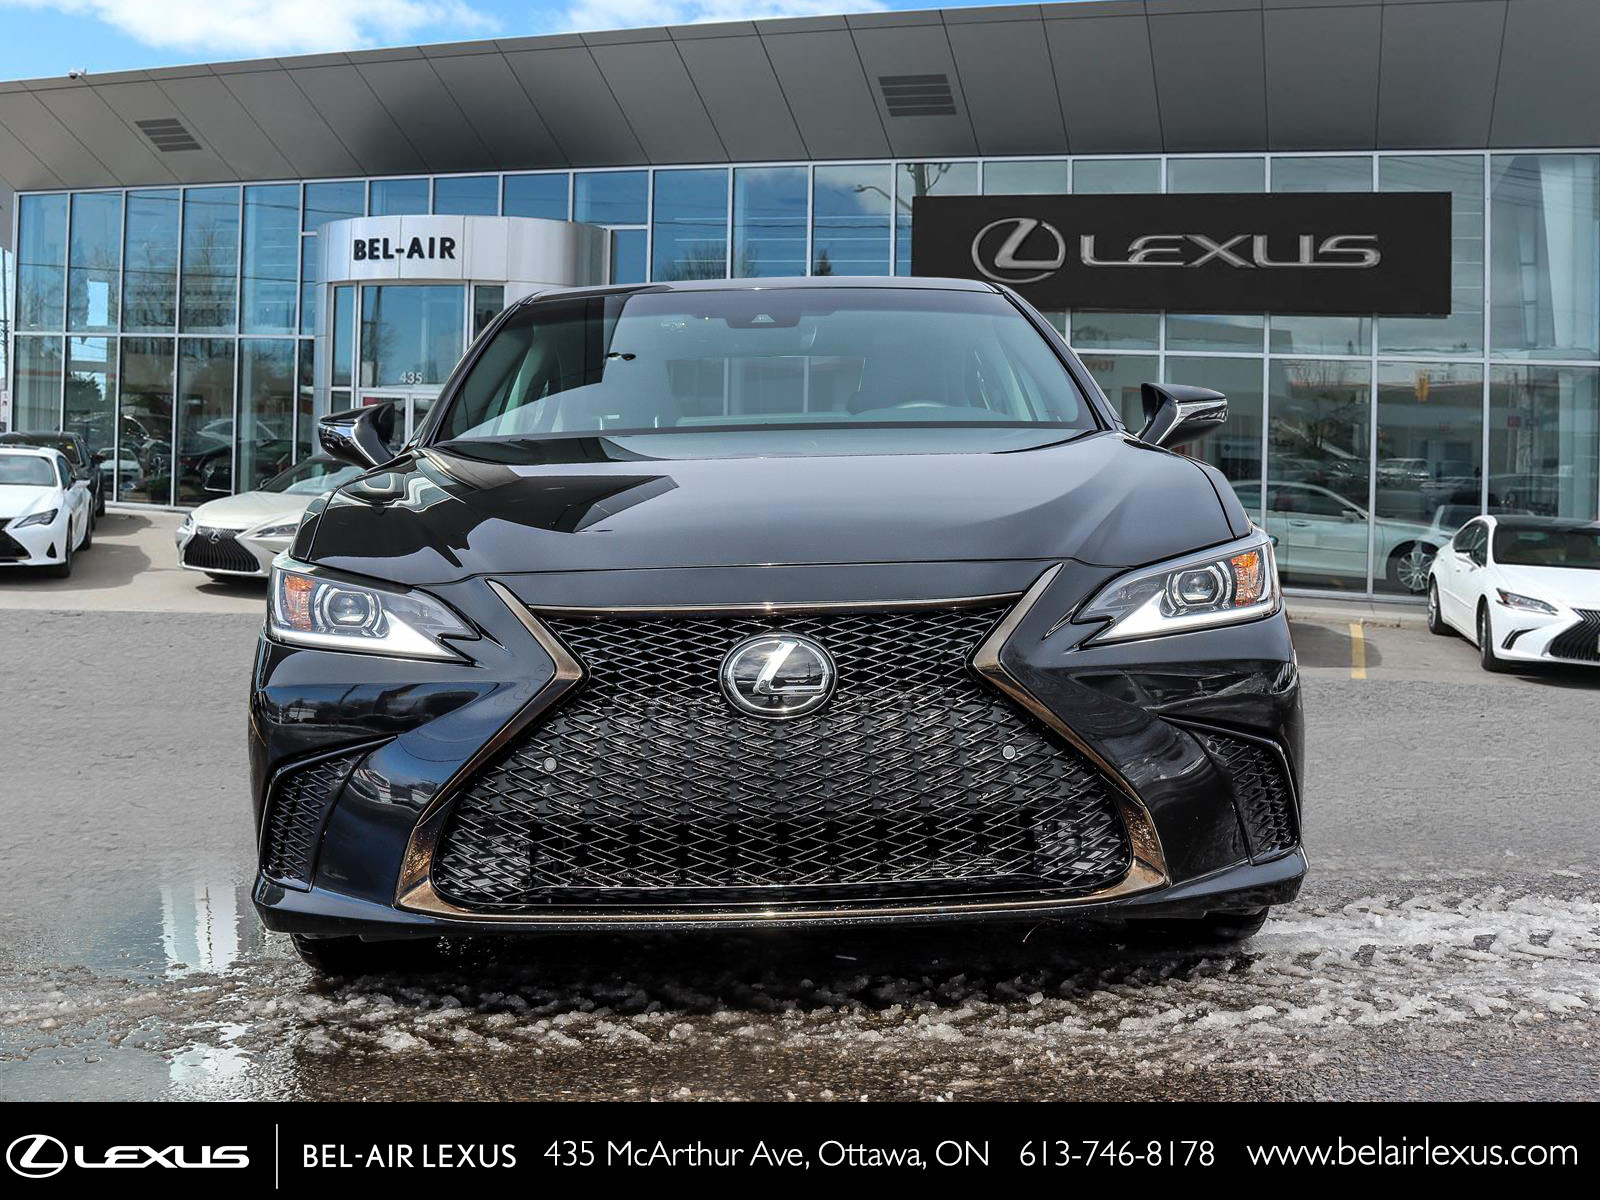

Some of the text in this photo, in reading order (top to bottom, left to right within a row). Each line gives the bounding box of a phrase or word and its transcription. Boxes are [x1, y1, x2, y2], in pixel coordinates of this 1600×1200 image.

[353, 237, 456, 260] BEL-AIR
[1080, 234, 1382, 269] LEXUS
[400, 371, 424, 385] 435
